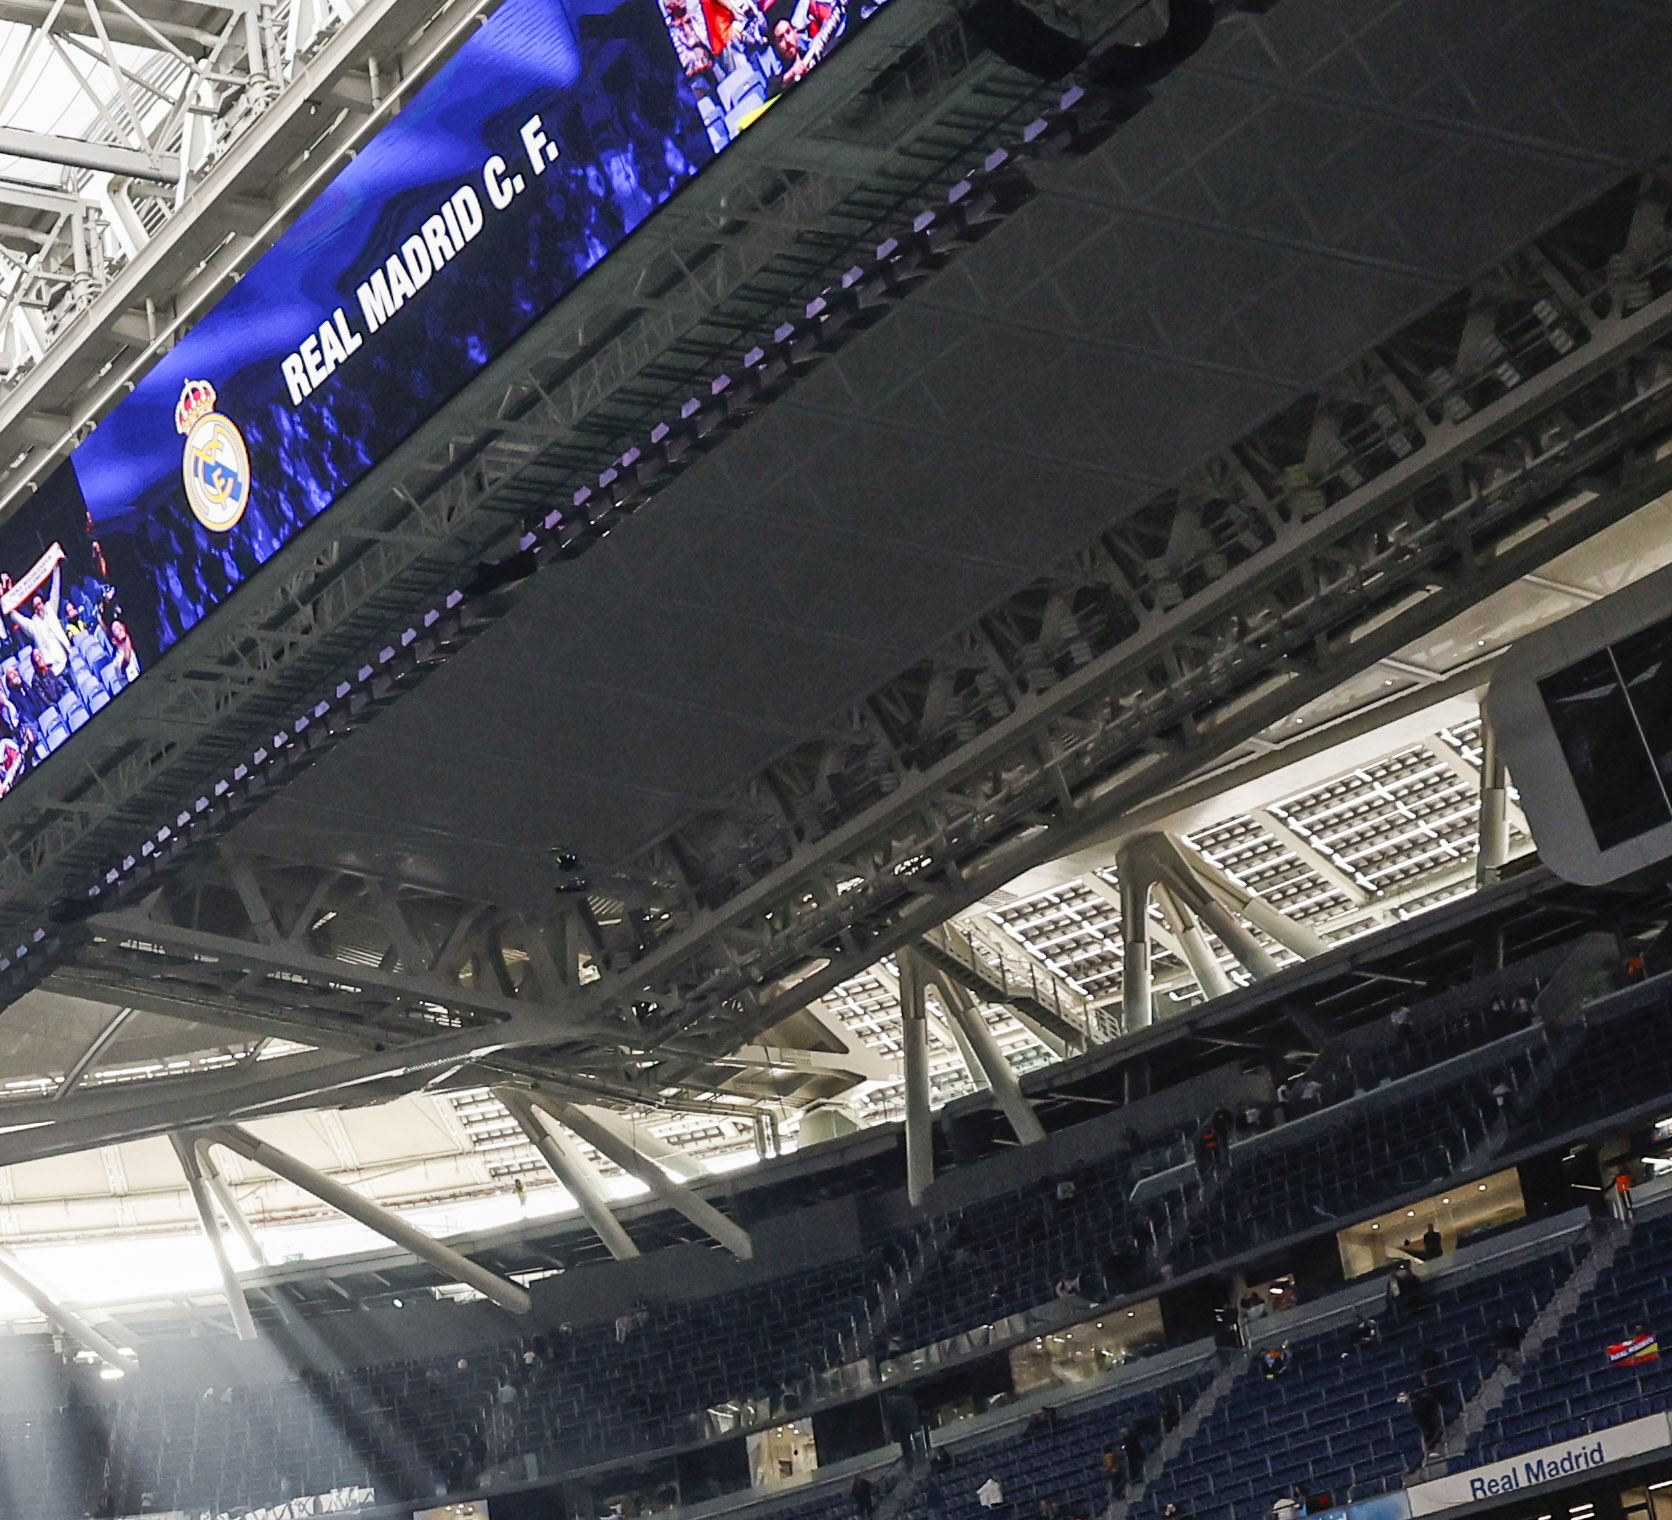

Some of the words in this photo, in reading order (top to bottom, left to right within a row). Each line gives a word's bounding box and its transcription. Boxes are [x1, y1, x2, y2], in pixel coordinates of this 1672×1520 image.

[281, 307, 362, 406] REAL
[356, 184, 484, 334] MADRID
[483, 155, 526, 210] C.
[520, 114, 559, 175] F.
[1469, 1468, 1520, 1499] Real
[1525, 1443, 1605, 1484] Madrid
